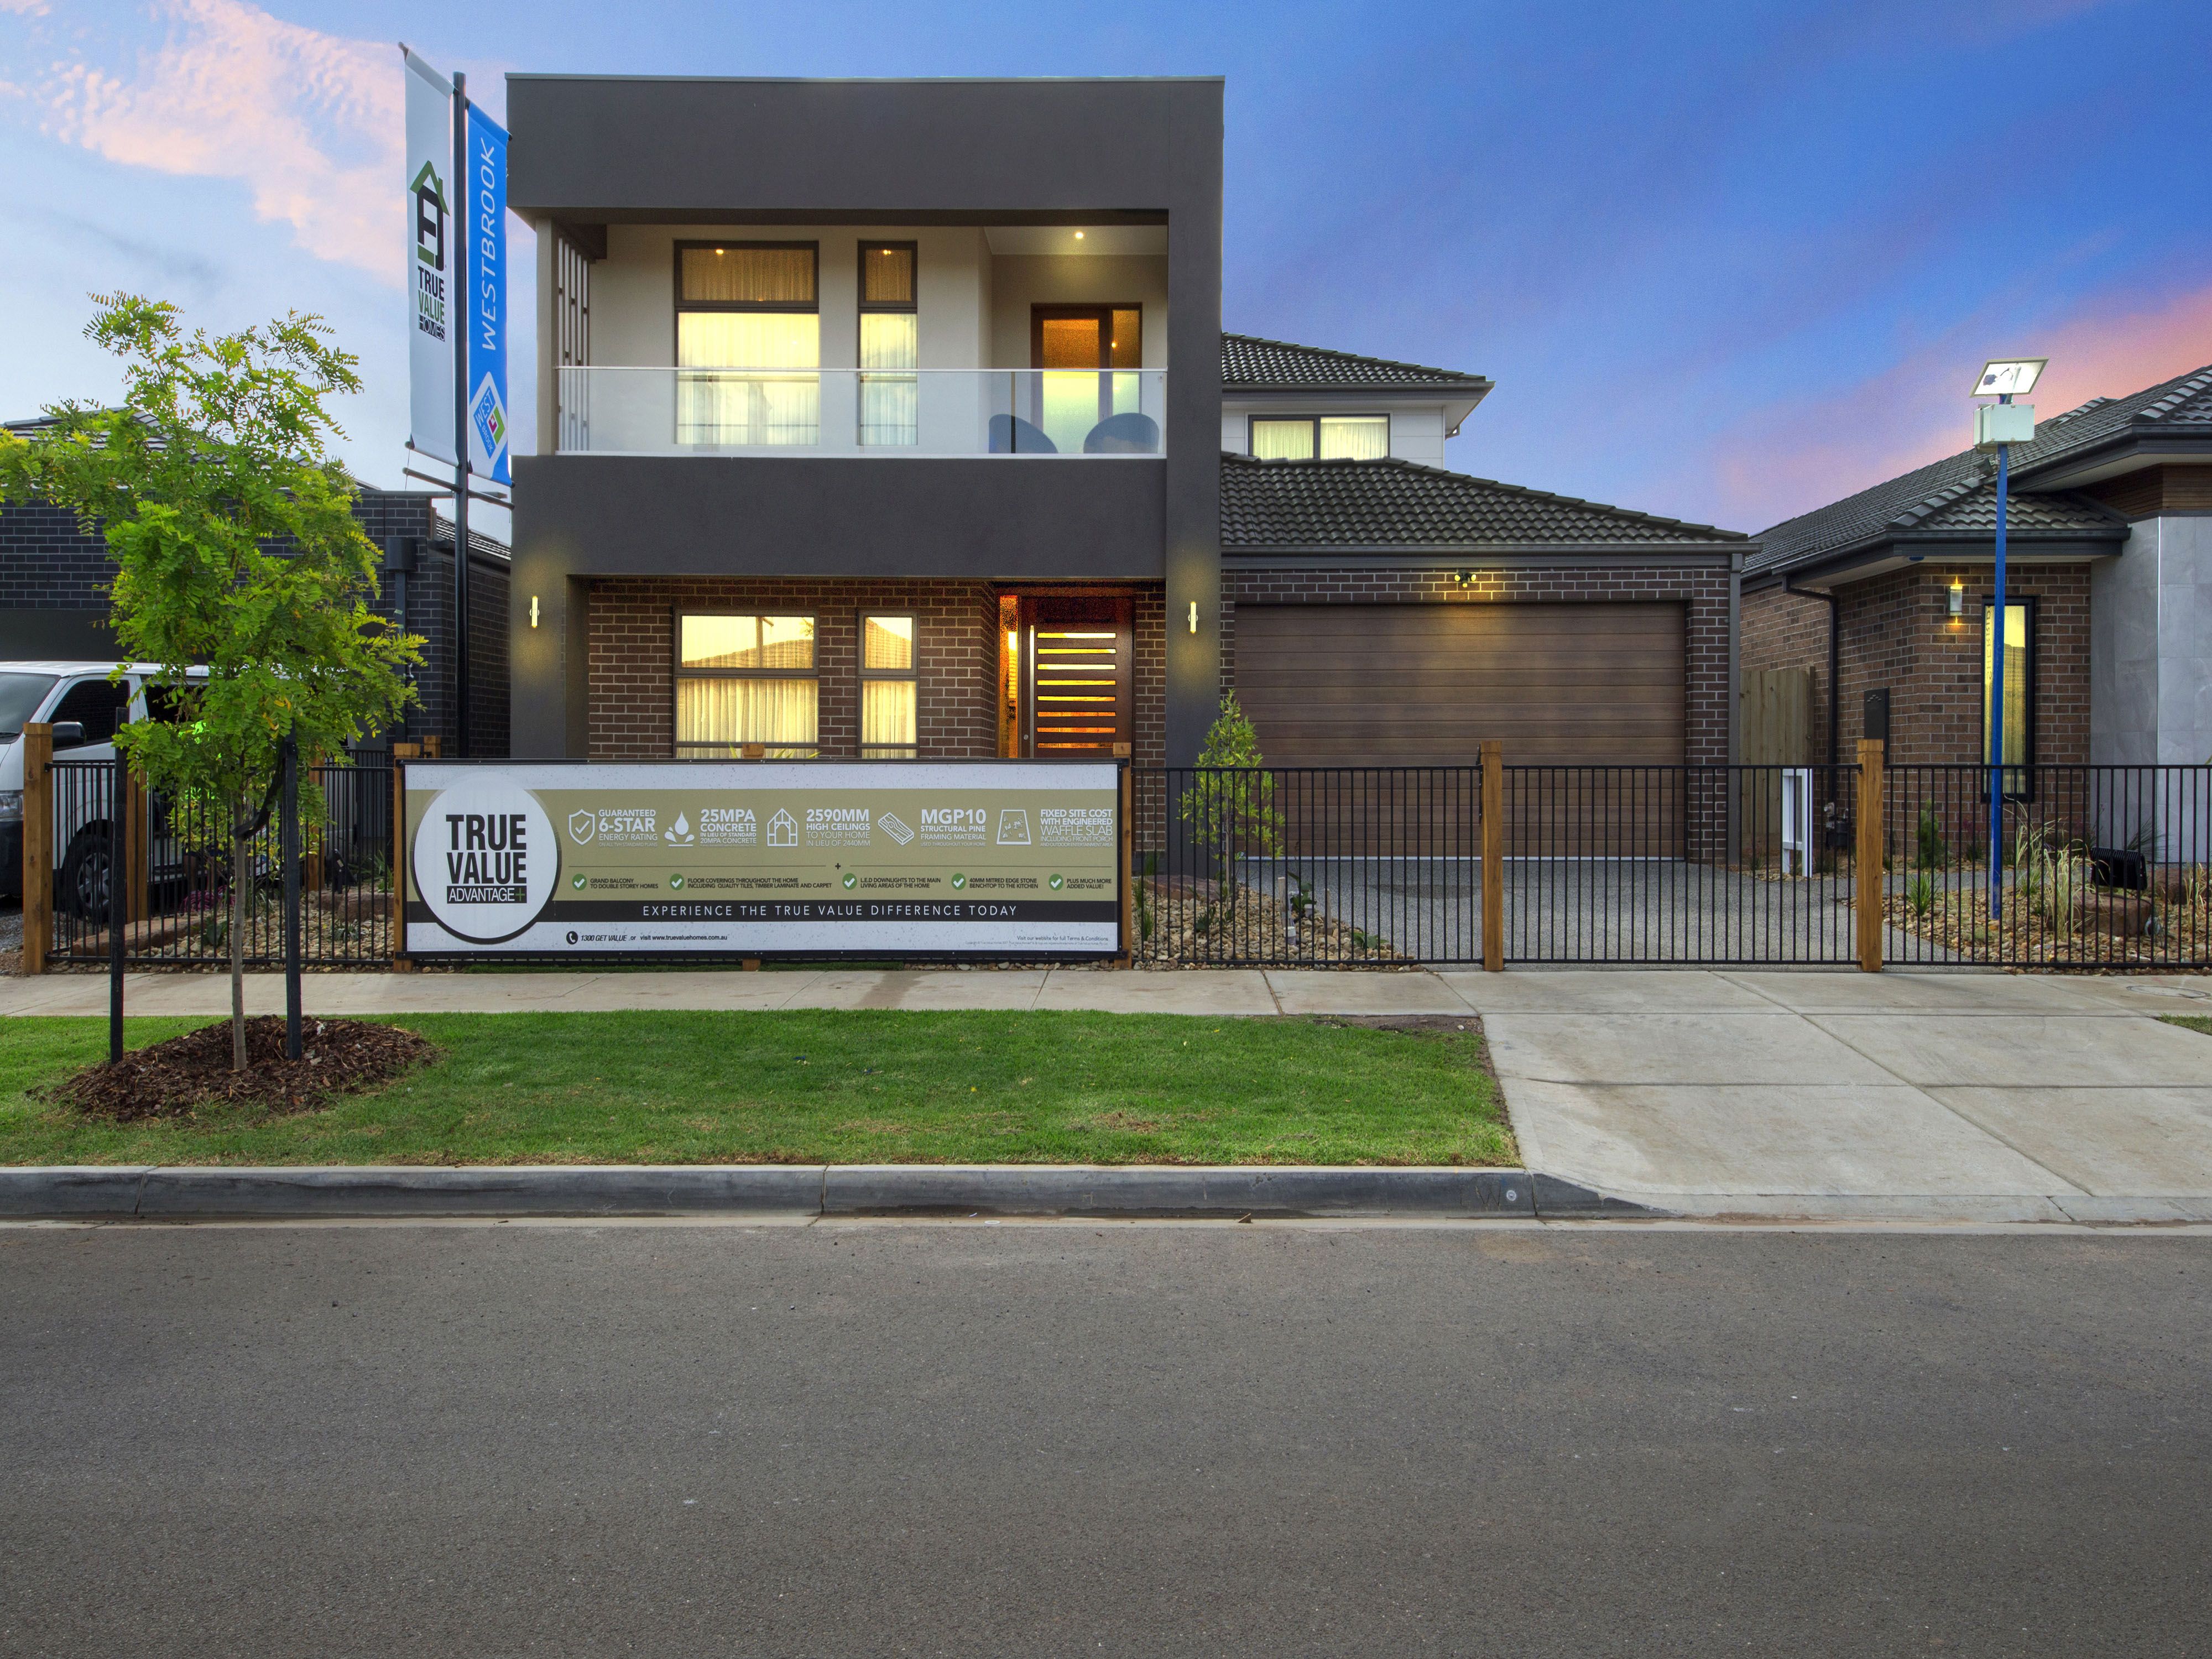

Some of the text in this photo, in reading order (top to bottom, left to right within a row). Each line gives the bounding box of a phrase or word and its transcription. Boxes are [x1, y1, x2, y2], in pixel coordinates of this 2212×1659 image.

[481, 137, 495, 350] WESTBROOK
[418, 266, 444, 301] TRUE
[419, 290, 445, 325] VALUE
[419, 315, 445, 341] HOMES
[476, 391, 493, 427] WEST
[482, 425, 493, 452] BROOK
[700, 809, 756, 822] 25MPA
[806, 809, 869, 822] 2590MM
[921, 809, 986, 824] MGP10
[1041, 809, 1113, 817] FIXED SITE COST
[446, 815, 526, 851] TRUE
[599, 818, 655, 832] 6-STAR
[700, 823, 757, 832] CONCRETE
[1041, 826, 1112, 836] WAFFLE SLAB
[447, 852, 526, 884] VALUE
[643, 905, 1017, 916] EXPERIENCE THE TRUE VALUE DIFFERENCE TODAY
